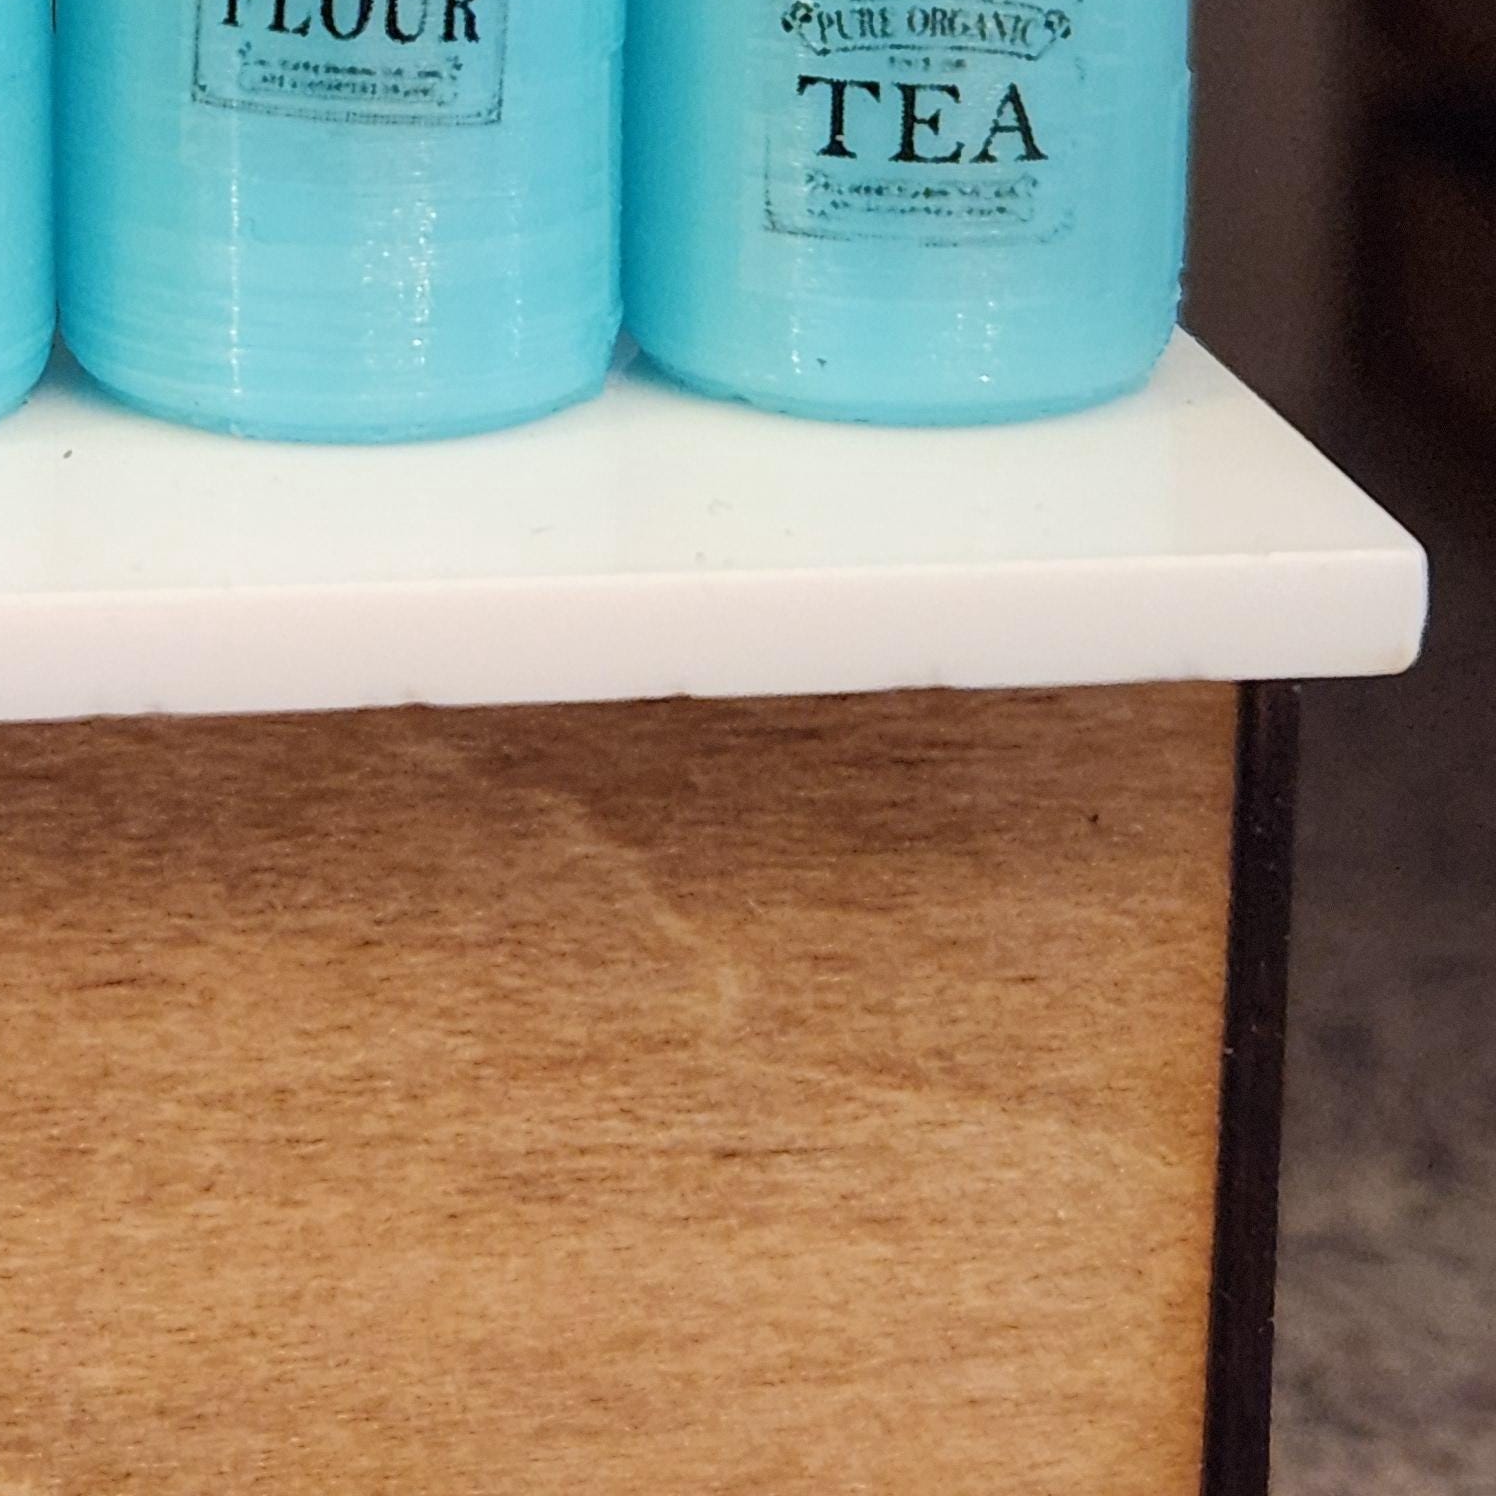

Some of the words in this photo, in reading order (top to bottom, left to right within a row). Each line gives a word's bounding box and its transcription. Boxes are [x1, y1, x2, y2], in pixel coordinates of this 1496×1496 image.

[818, 7, 896, 42] PURE
[907, 7, 1039, 46] ORGANIC
[797, 75, 1048, 163] TEA
